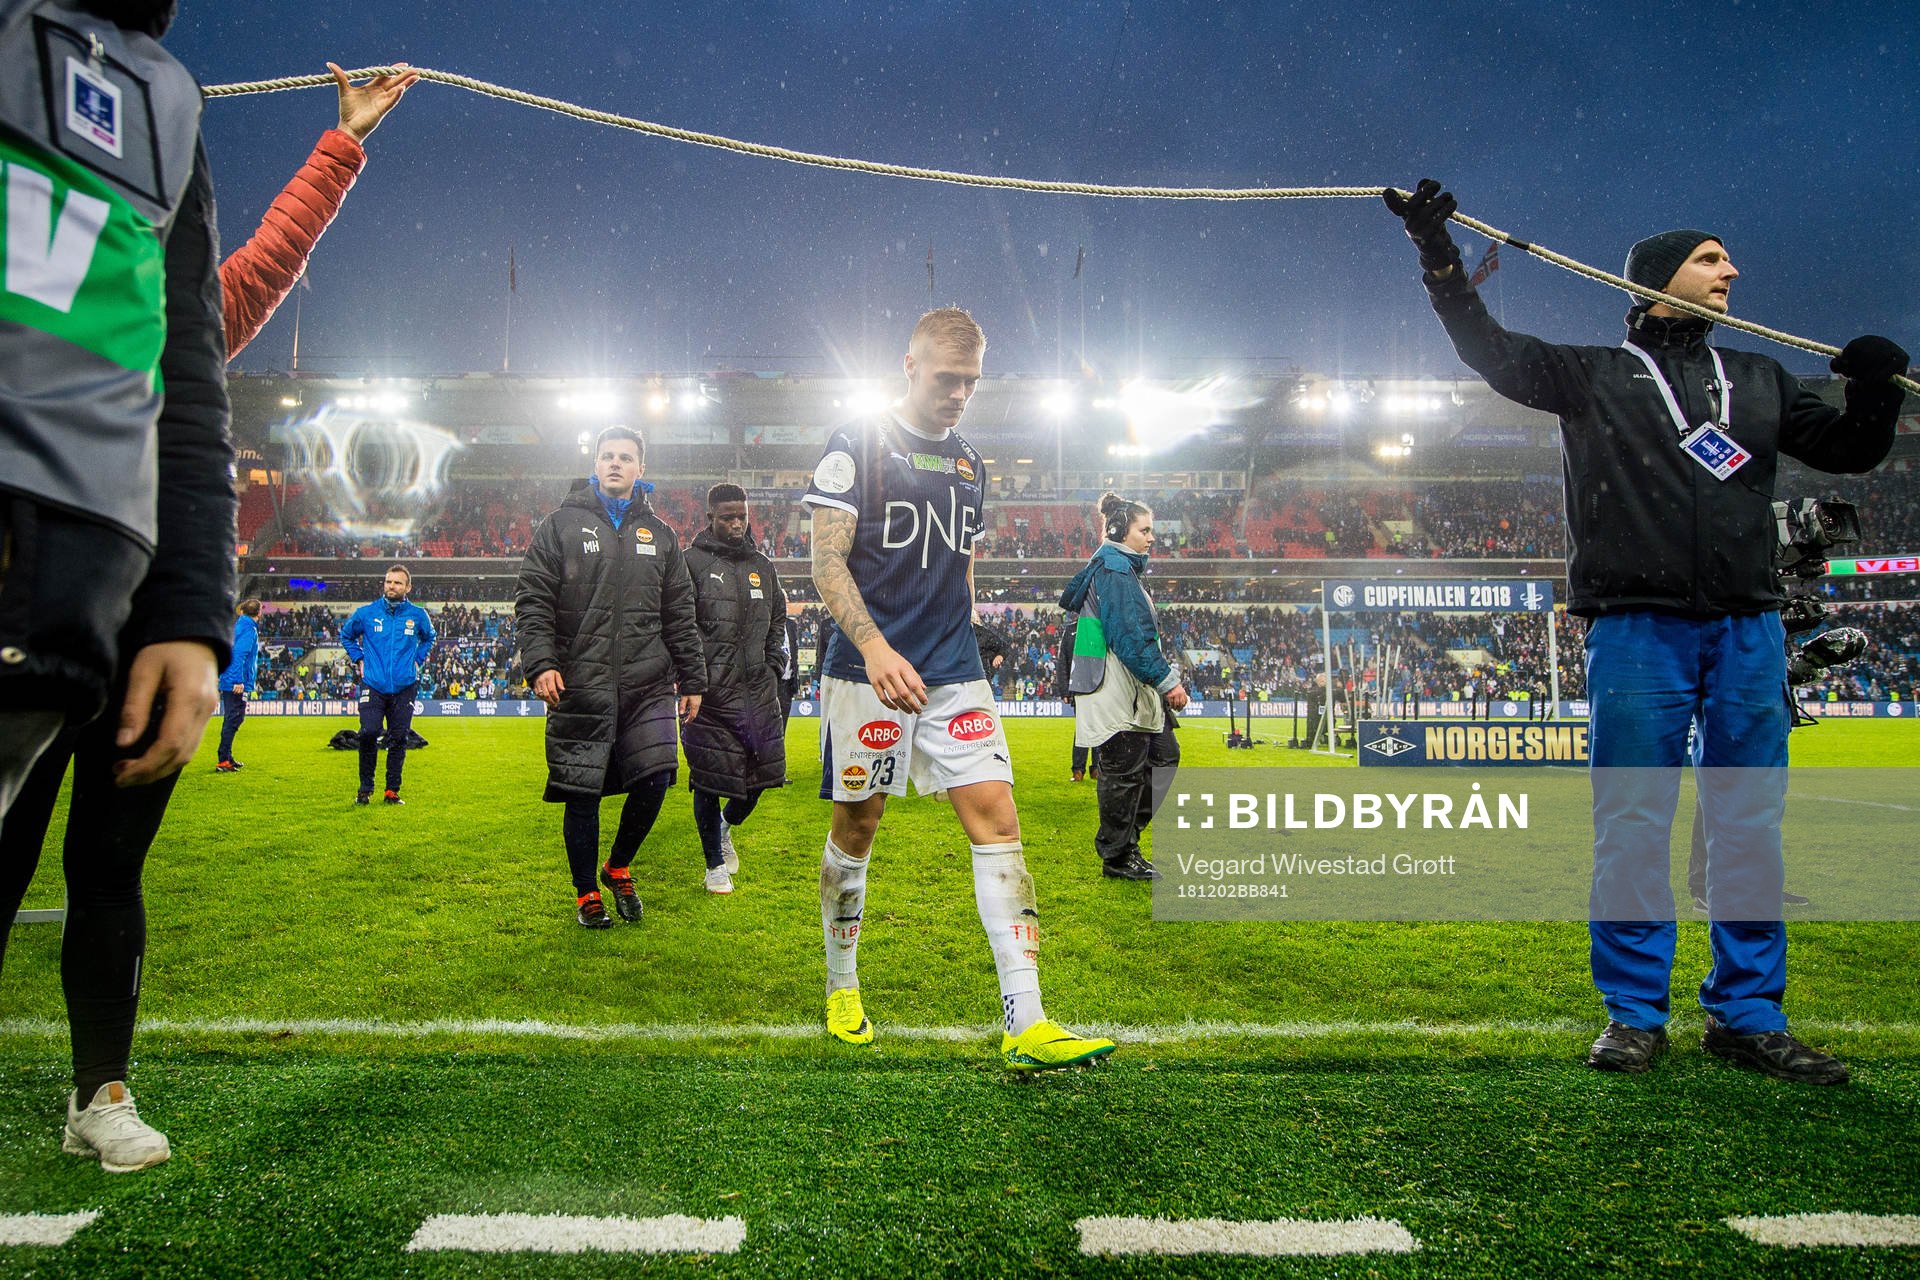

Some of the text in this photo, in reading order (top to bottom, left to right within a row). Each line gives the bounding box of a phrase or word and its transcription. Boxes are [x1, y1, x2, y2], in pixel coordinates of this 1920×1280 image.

[0, 160, 111, 314] V
[583, 540, 599, 554] MH
[1856, 559, 1916, 573] VG
[1364, 586, 1511, 607] CUPFINALEN 2018
[302, 701, 323, 715] MED
[1036, 701, 1062, 716] 2018
[1851, 702, 1874, 716] 2018
[860, 727, 902, 743] ARBO
[951, 717, 995, 737] ARBO
[1425, 726, 1589, 760] NORGESME
[869, 756, 896, 791] 23
